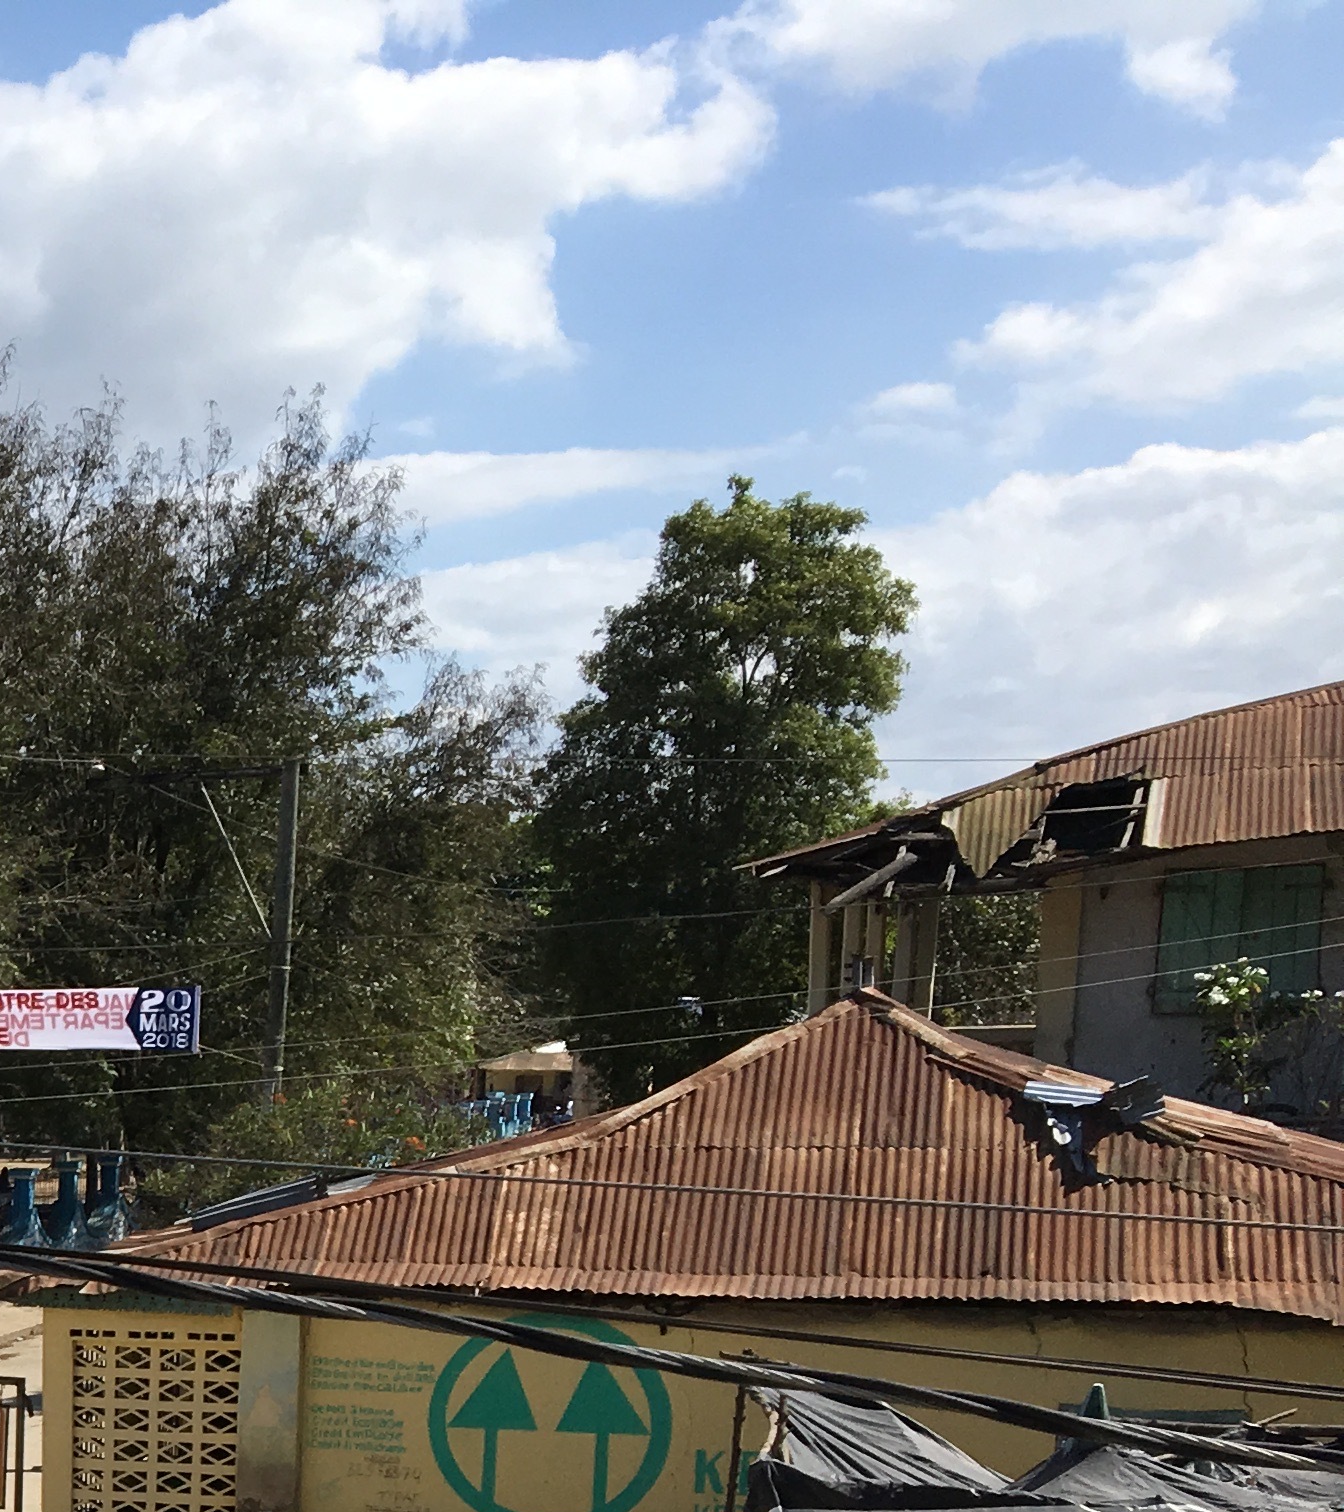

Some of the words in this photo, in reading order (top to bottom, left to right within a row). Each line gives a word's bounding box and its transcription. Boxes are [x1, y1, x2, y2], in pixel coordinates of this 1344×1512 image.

[56, 991, 100, 1009] DES
[139, 990, 192, 1013] 20
[138, 1013, 191, 1032] MARS
[141, 1032, 190, 1049] 2018
